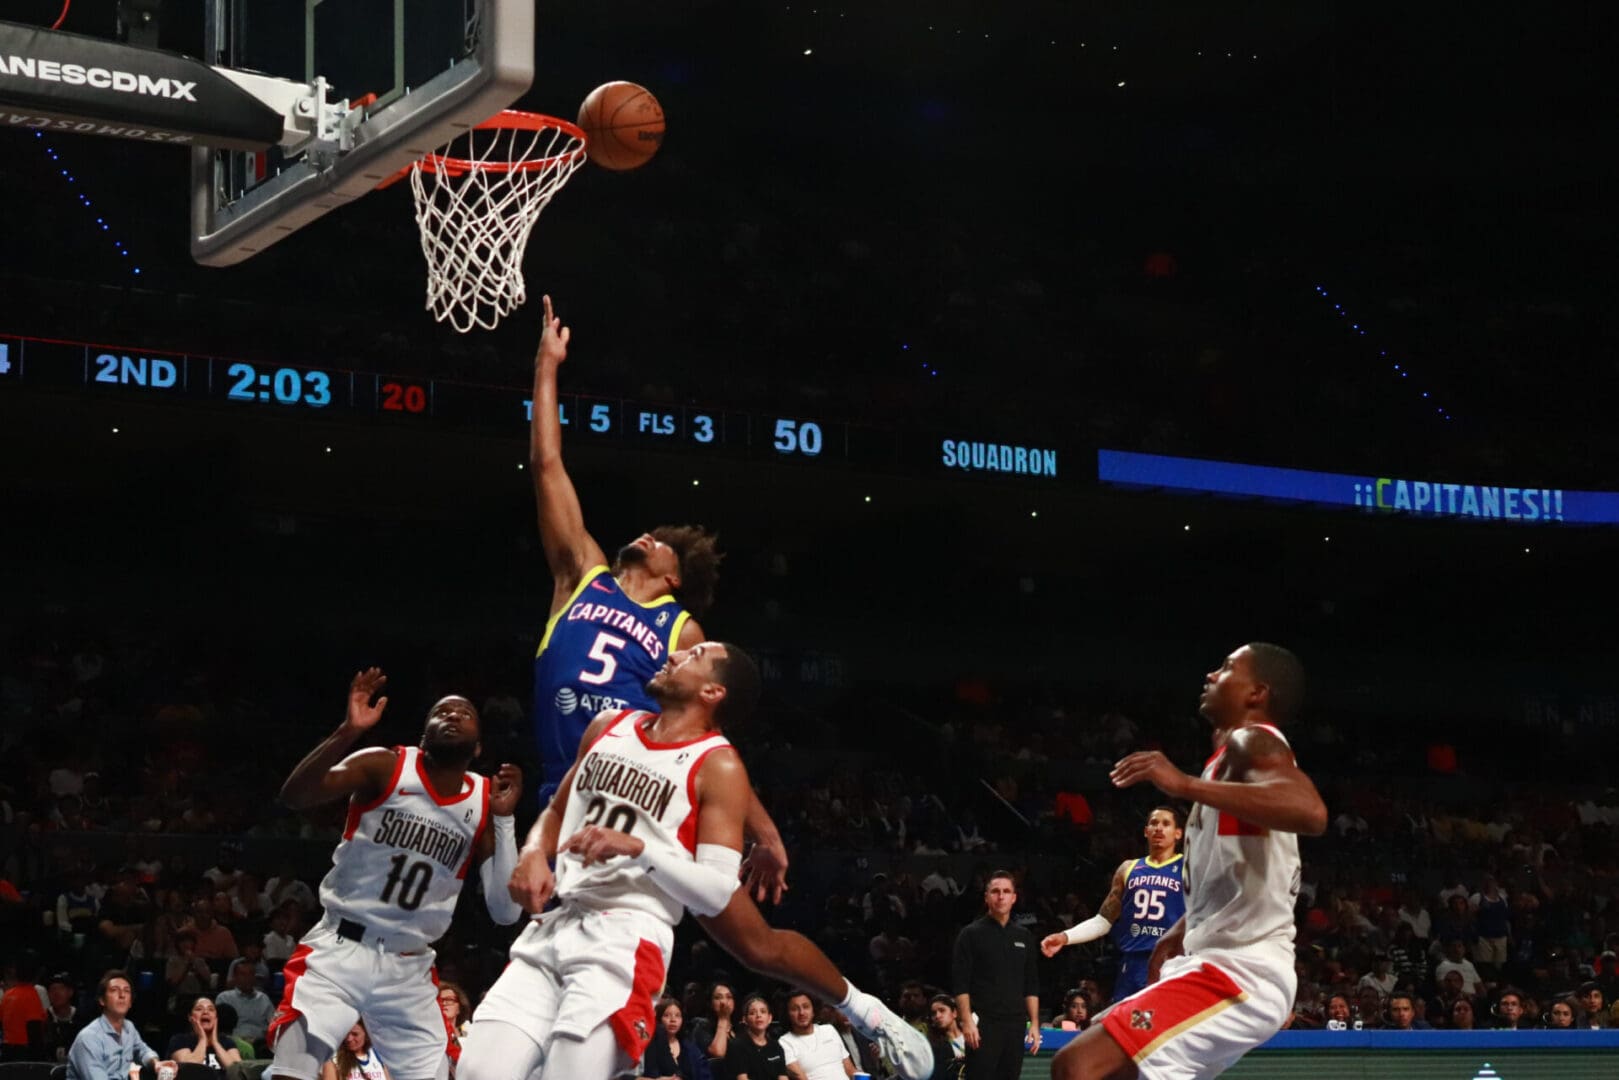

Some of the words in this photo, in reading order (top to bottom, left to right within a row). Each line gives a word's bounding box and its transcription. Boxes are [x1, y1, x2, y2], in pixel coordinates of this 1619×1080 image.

[0, 112, 193, 143] #SOMOSCA
[95, 354, 177, 388] 2ND
[227, 363, 331, 406] 2:03
[383, 382, 426, 413] 20
[523, 400, 569, 425] TL
[590, 404, 611, 433] 5
[639, 412, 675, 435] FLS
[694, 415, 714, 442] 3
[774, 419, 822, 454] 50
[942, 440, 1057, 477] SQUADRON
[567, 603, 664, 661] CAPITANES
[578, 631, 626, 685] 5
[580, 693, 629, 712] AT&T
[576, 752, 678, 823] SQUADRON
[373, 808, 466, 872] SQUADRON
[396, 811, 465, 841] BIRMINGHAM
[380, 852, 434, 912] 10
[1128, 875, 1181, 892] CAPITANES
[1133, 888, 1167, 921] 95
[1141, 926, 1167, 937] AT&T
